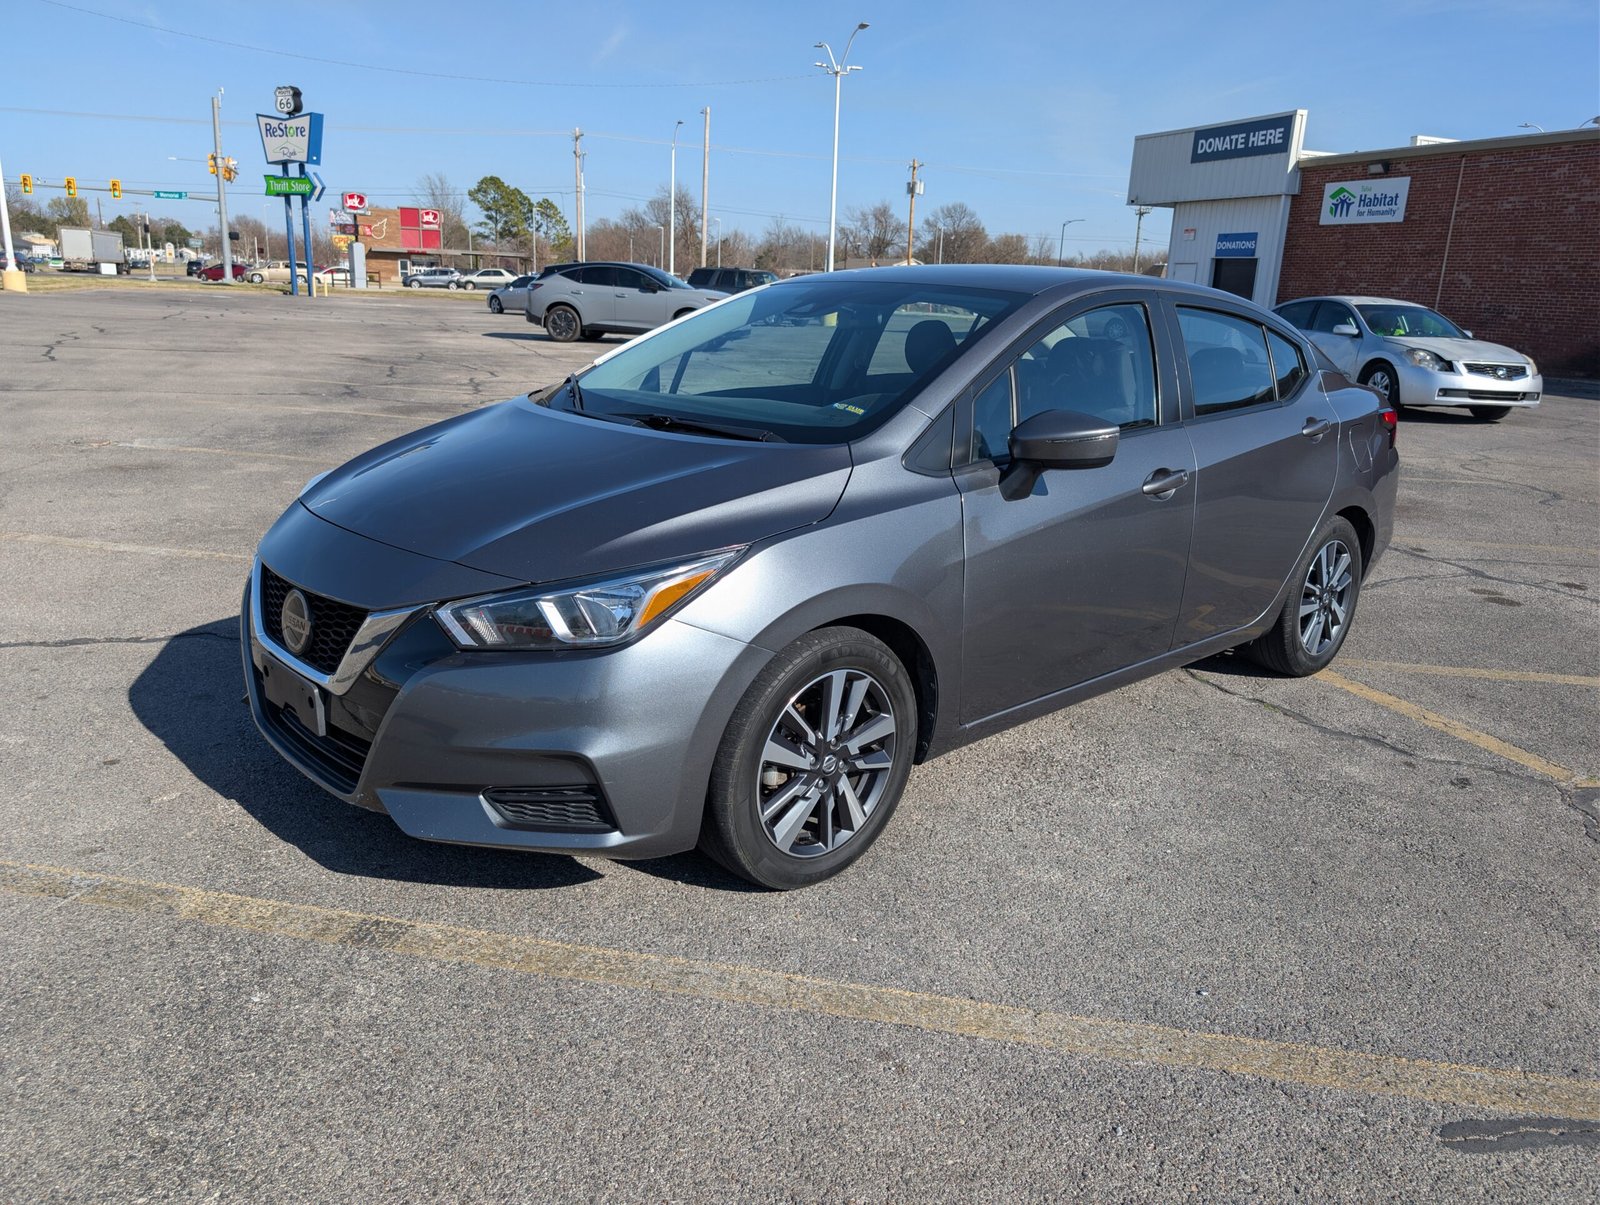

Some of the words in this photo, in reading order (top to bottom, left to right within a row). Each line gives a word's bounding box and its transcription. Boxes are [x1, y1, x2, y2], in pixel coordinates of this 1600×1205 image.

[279, 98, 292, 110] 66
[264, 122, 306, 138] ReStore
[1197, 133, 1246, 154] DONATE
[1248, 127, 1285, 148] HERE
[269, 180, 289, 191] Thrift
[291, 180, 310, 192] Store
[1358, 193, 1399, 208] Habitat
[1356, 209, 1365, 217] for
[1366, 207, 1397, 217] Humanity
[1216, 240, 1256, 250] DONATIONS
